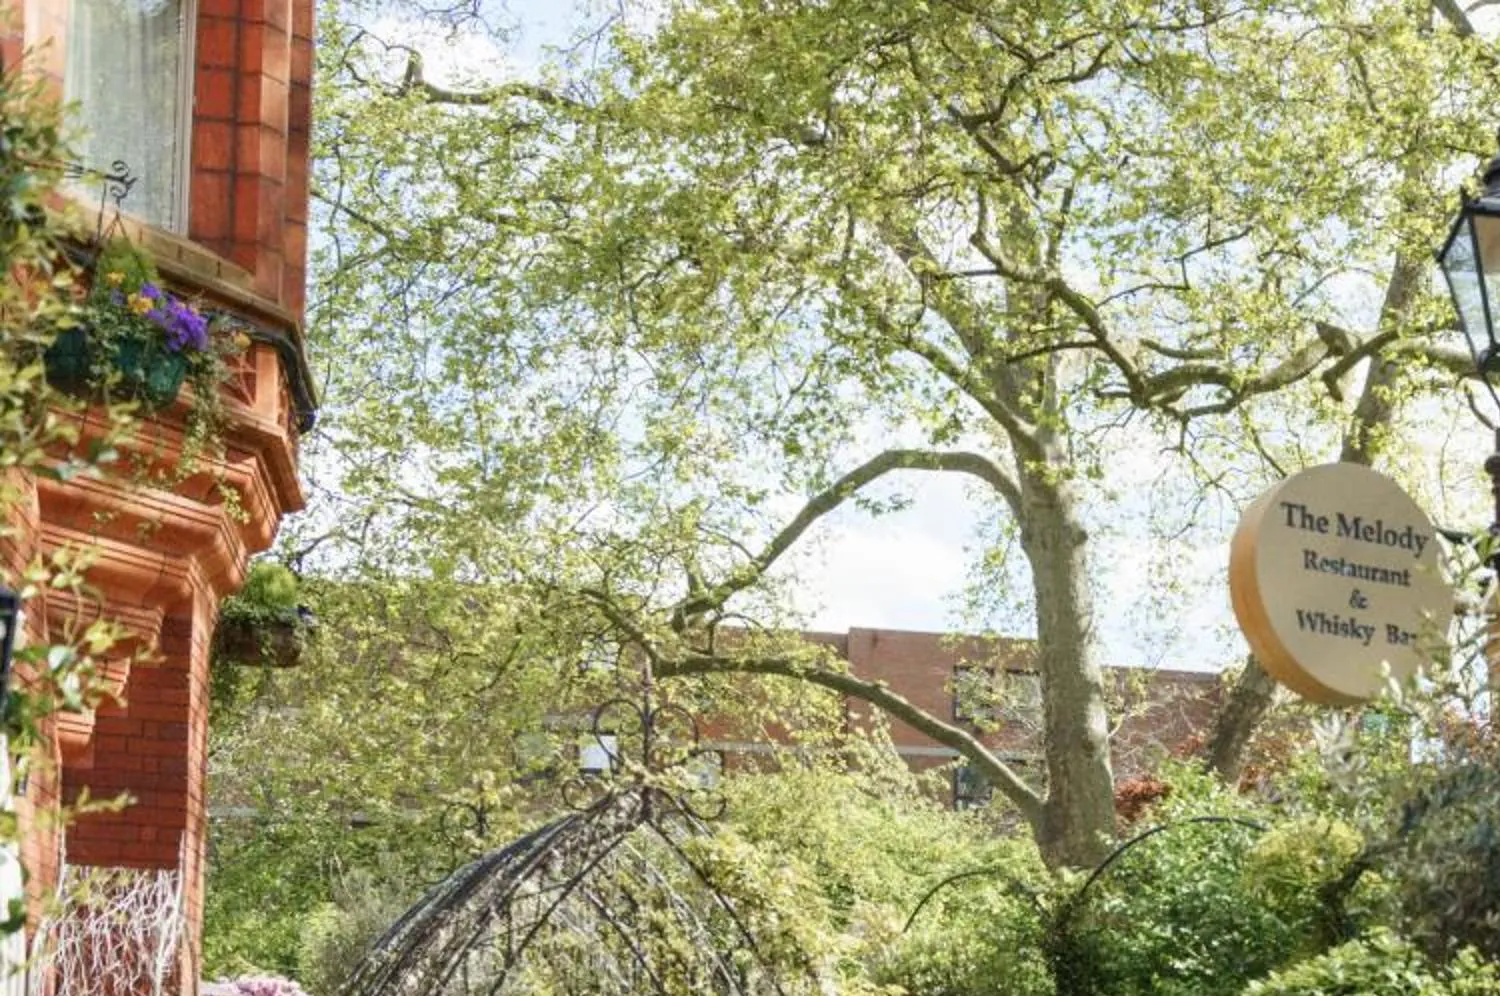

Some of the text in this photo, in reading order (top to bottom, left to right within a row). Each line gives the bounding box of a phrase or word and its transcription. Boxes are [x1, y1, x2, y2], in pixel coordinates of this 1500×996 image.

[1281, 501, 1429, 558] The Melody
[1303, 549, 1413, 587] Restaurant
[1349, 589, 1368, 610] &
[1296, 609, 1376, 647] Whisky
